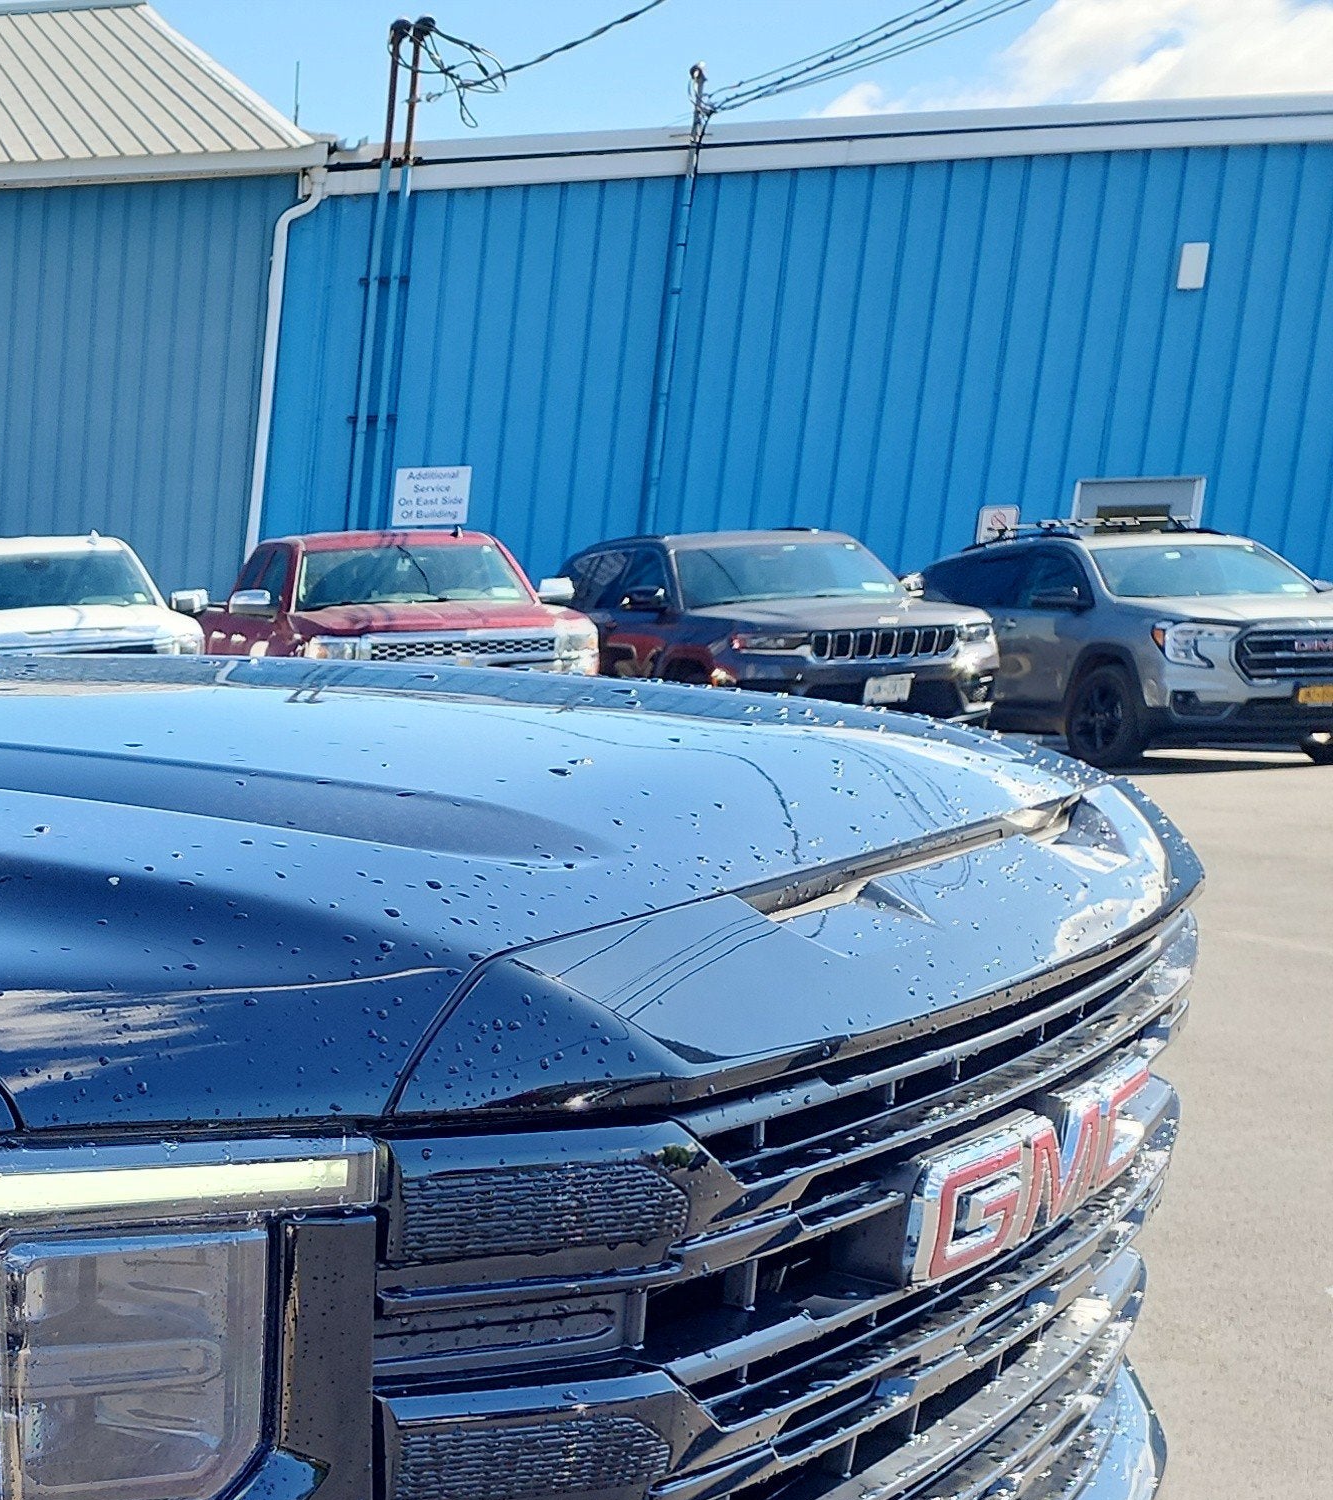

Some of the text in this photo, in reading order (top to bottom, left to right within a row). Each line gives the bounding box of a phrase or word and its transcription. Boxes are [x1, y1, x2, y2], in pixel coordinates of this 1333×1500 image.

[407, 470, 460, 480] Additional
[413, 484, 451, 493] Service
[398, 496, 463, 507] On East Side
[401, 509, 459, 520] Of Building
[915, 1062, 1150, 1283] GMC
